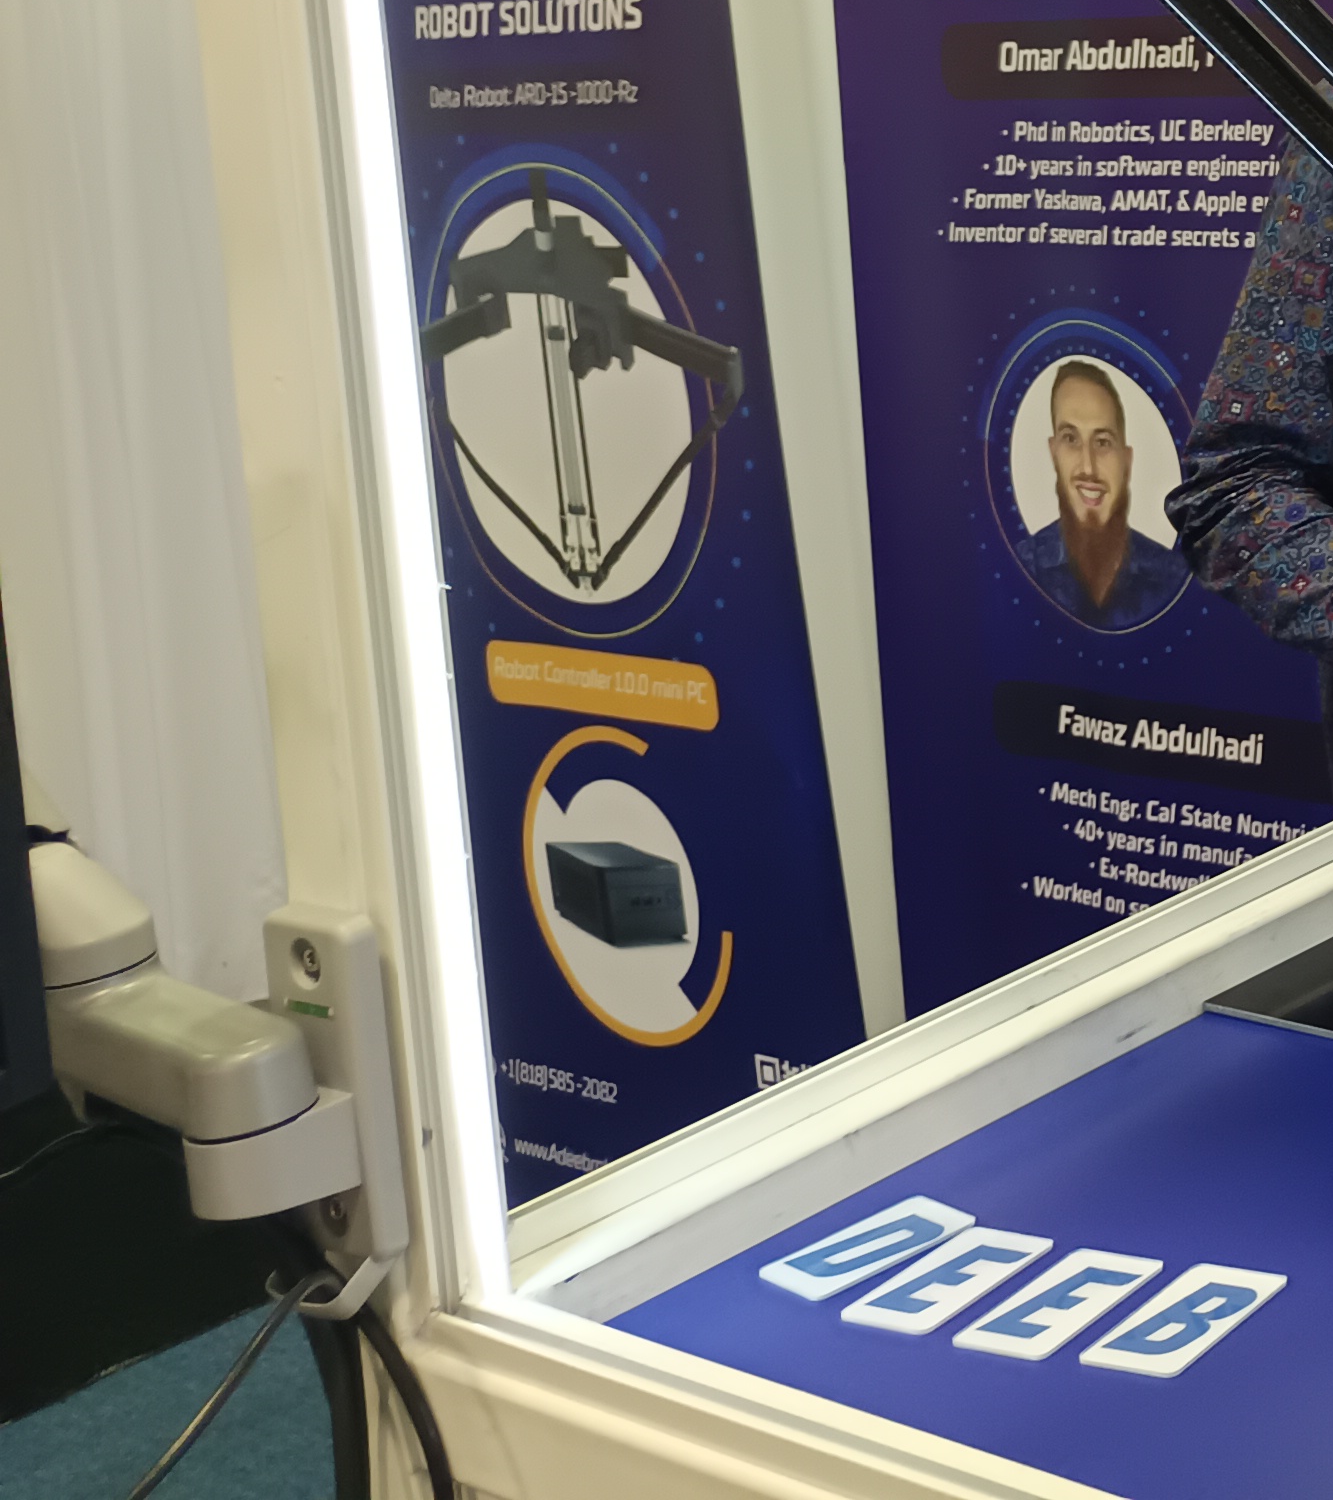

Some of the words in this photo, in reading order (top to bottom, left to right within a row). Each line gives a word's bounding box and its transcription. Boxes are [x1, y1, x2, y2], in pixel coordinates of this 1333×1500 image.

[415, 2, 495, 40] ROBOT
[999, 40, 1064, 73] Omar
[1065, 35, 1199, 73] Abdulhadi,
[1014, 120, 1048, 143] Phd
[1051, 120, 1066, 143] in
[1069, 120, 1155, 145] Robotics,
[1159, 119, 1187, 142] UC
[1189, 119, 1274, 146] Berkeley
[994, 154, 1027, 177] 10+
[1030, 158, 1074, 180] years
[1077, 154, 1092, 177] in
[1095, 154, 1182, 178] software
[964, 188, 1031, 211] Former
[1034, 188, 1107, 215] Yaskawa,
[1110, 189, 1173, 214] AMAT,
[1176, 189, 1191, 212] &
[1194, 190, 1246, 217] Apple
[949, 221, 1026, 244] Inventor
[1028, 222, 1048, 244] of
[1049, 224, 1108, 246] several
[1112, 224, 1167, 247] trade
[1171, 227, 1240, 248] secrets
[494, 655, 540, 681] Robot
[544, 660, 612, 691] Controller
[653, 679, 683, 700] mini
[687, 680, 708, 704] PC
[1058, 704, 1127, 747] Fawaz
[1131, 718, 1264, 765] Abdulhadi
[1050, 781, 1097, 809] Mech
[1100, 791, 1142, 822] Engr.
[1146, 800, 1177, 824] Cal
[1180, 804, 1232, 833] State
[1236, 813, 1318, 842] Northri
[1074, 818, 1104, 842] 40+
[1106, 830, 1155, 854] years
[1159, 834, 1178, 858] in
[1182, 842, 1260, 867] manufa
[1033, 876, 1102, 908] Worked
[1104, 895, 1125, 915] on
